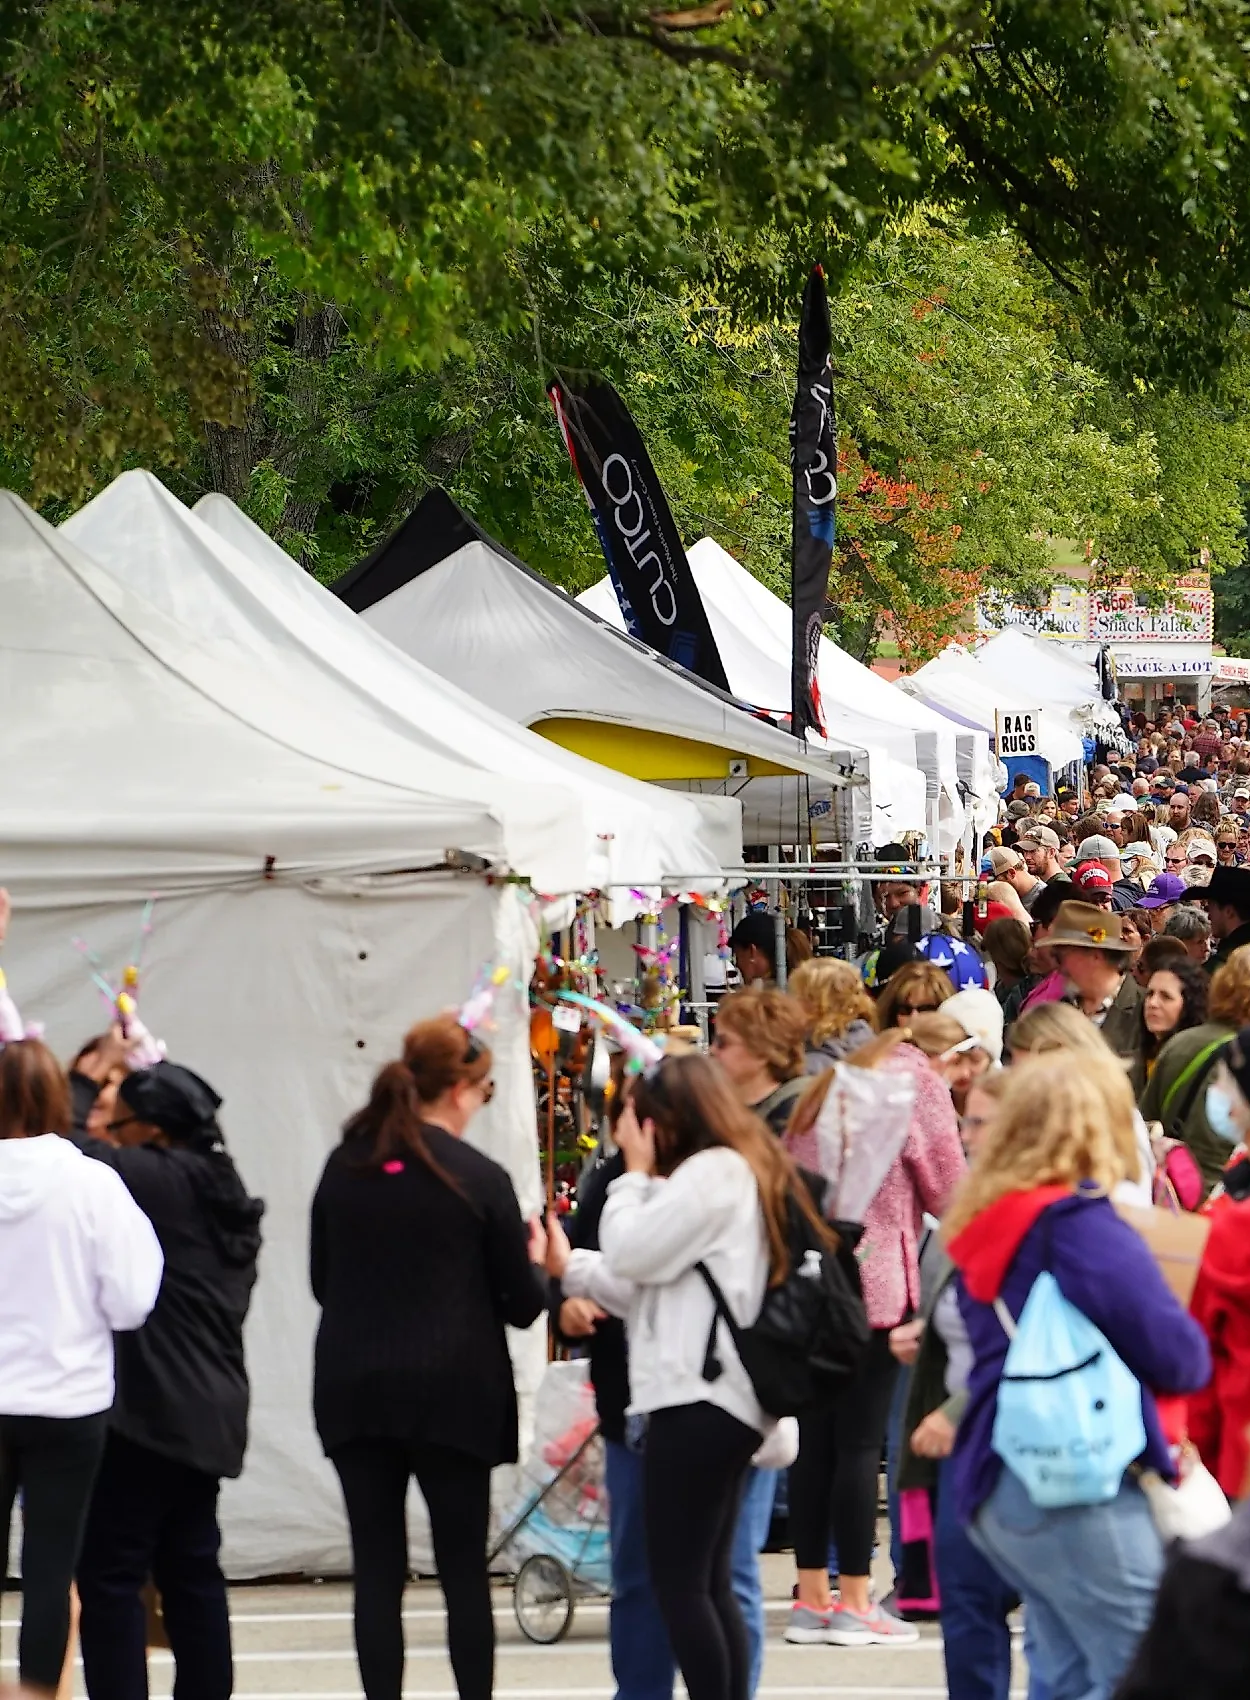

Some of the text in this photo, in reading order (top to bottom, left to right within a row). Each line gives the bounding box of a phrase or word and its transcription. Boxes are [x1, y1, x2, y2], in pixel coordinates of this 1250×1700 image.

[601, 453, 677, 626] CUTCO
[1096, 597, 1127, 614] FOOD
[1099, 616, 1144, 632] Snack
[1115, 661, 1213, 673] SNACK-A-LOT
[1004, 715, 1032, 733] RAG
[1001, 734, 1035, 752] RUGS
